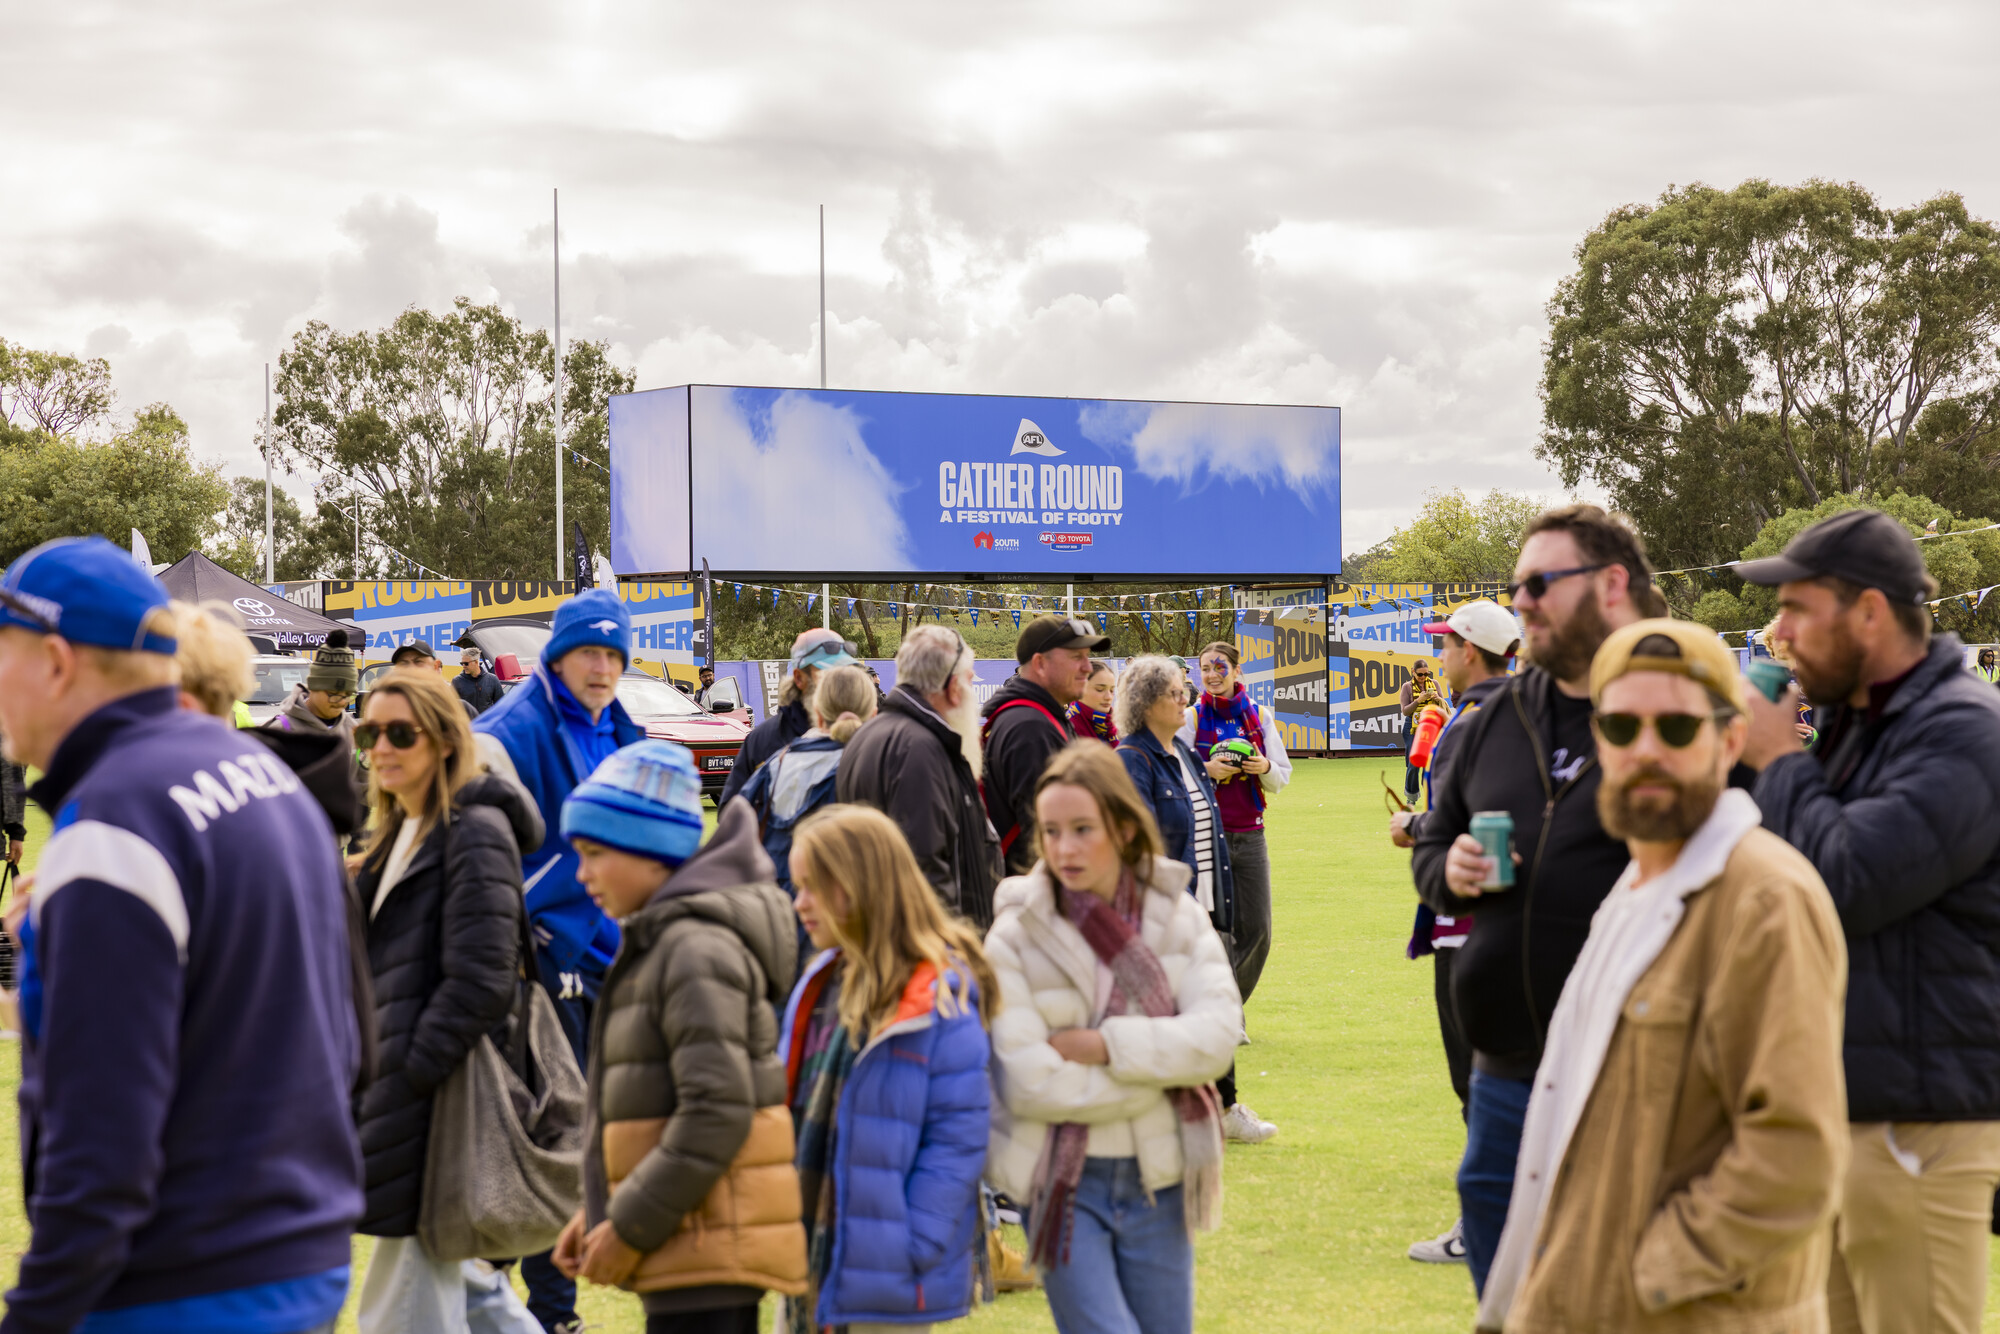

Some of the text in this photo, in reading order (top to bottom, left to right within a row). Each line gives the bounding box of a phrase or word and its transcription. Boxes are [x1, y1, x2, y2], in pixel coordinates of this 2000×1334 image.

[1023, 435, 1043, 445] AFL
[939, 461, 1122, 510] GATHER ROUND
[940, 510, 1123, 525] A FESTIVAL OF FOOTY
[994, 539, 1019, 547] SOUTH
[1039, 534, 1056, 543] AFL
[471, 582, 575, 608] ROUN
[247, 617, 295, 626] TOYOTA
[274, 631, 328, 646] Valley Toyo
[763, 662, 779, 716] ATHER
[708, 758, 734, 767] BVT 005
